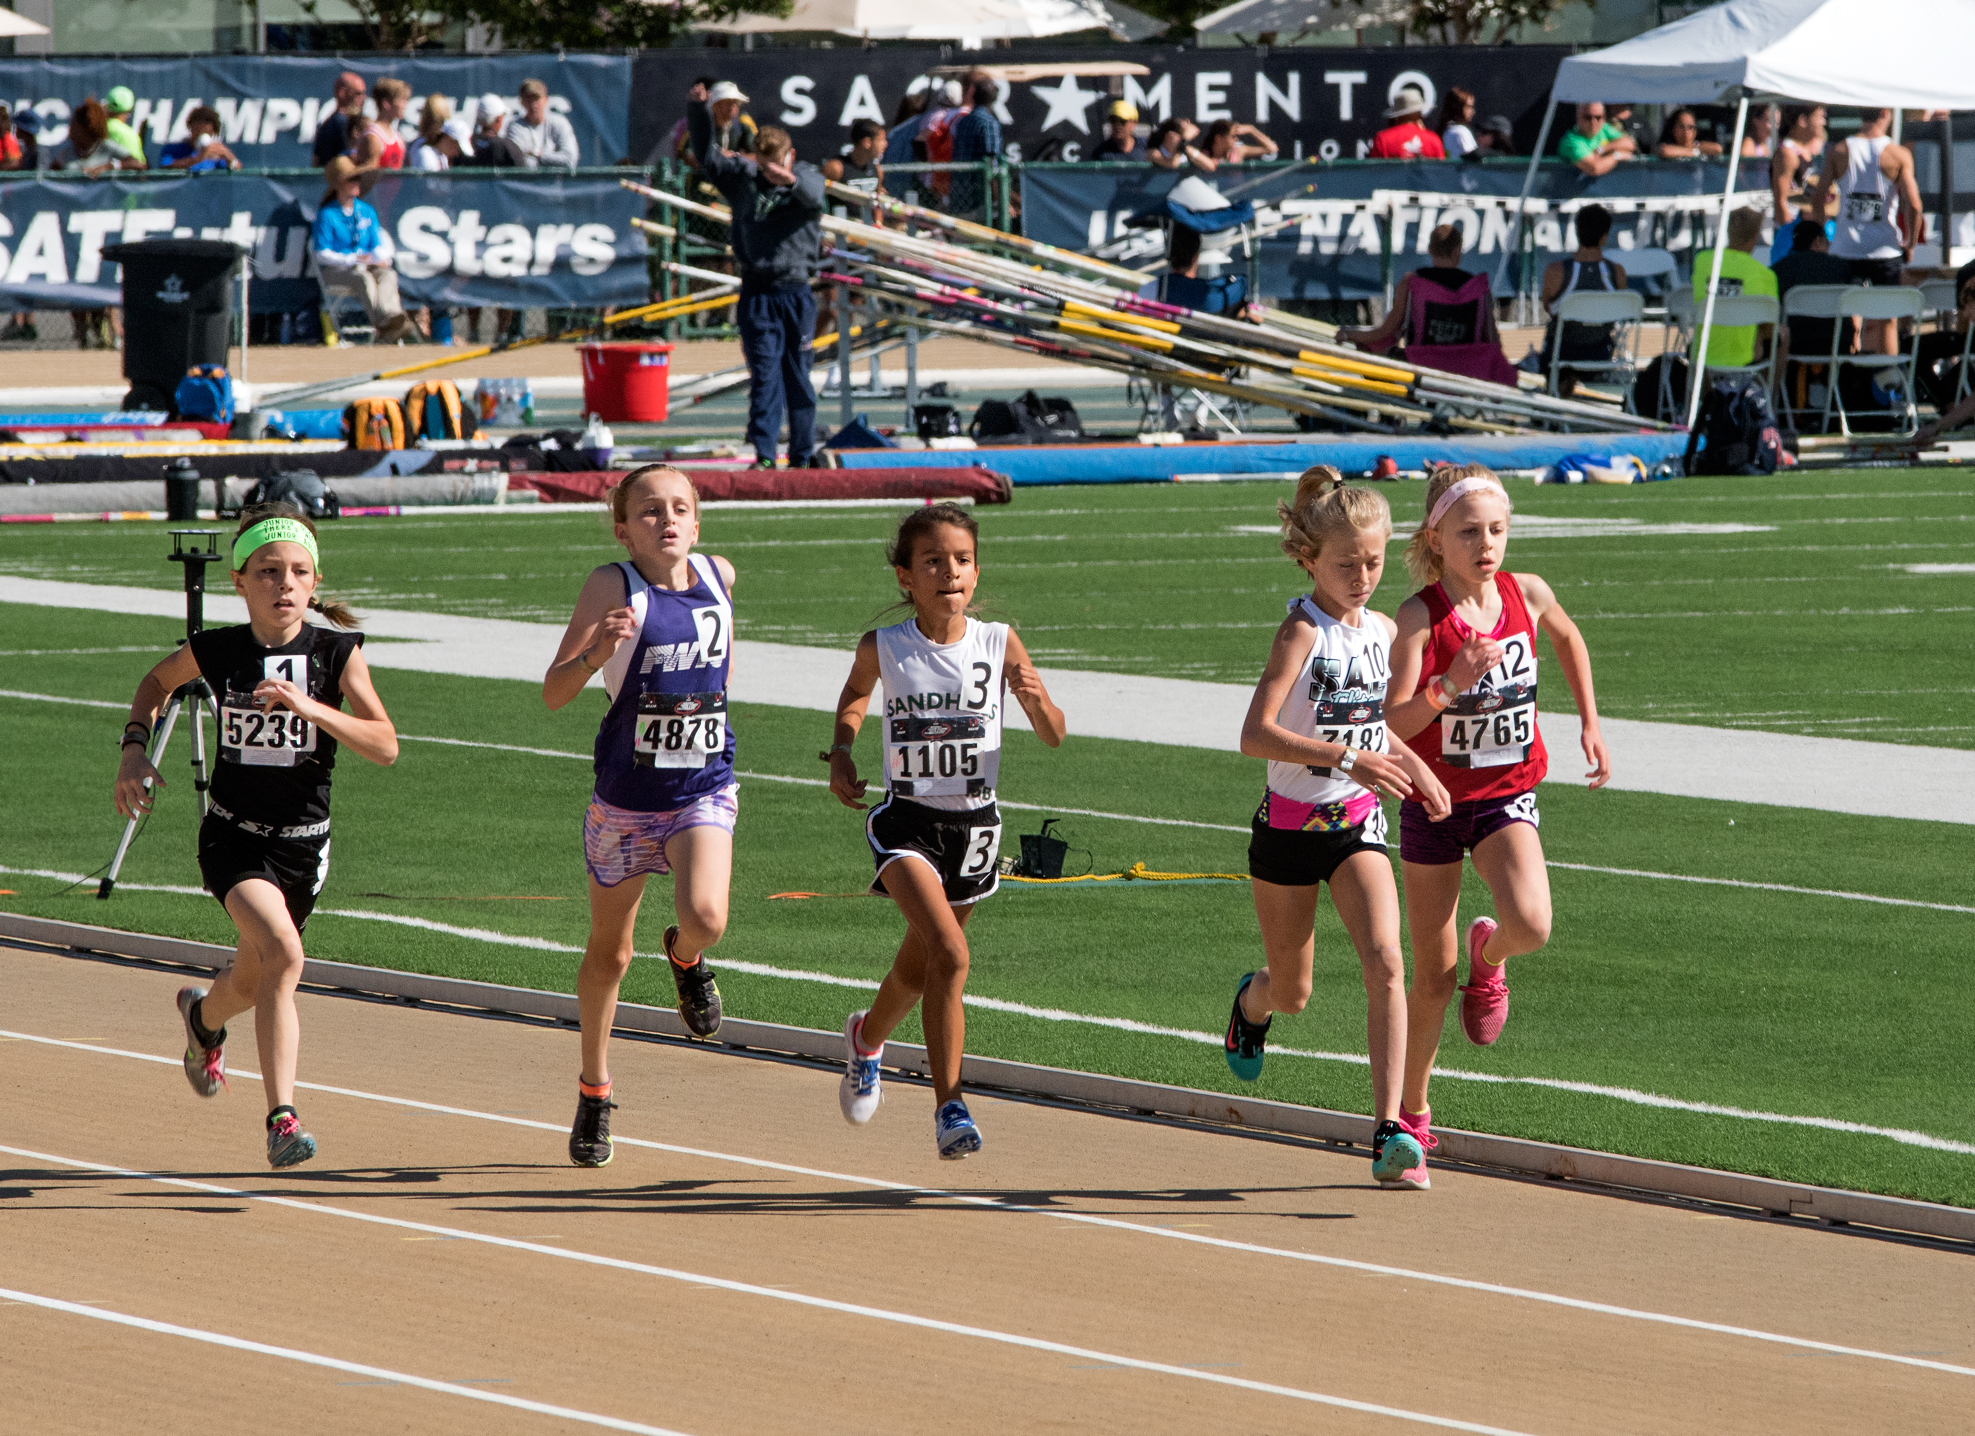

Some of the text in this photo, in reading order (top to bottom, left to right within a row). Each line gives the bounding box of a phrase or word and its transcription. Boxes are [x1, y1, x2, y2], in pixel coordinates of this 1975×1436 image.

[263, 518, 294, 527] JUNIOR
[265, 531, 297, 541] JUNIOR
[701, 610, 722, 657] 2
[276, 658, 294, 682] 1
[1363, 641, 1385, 679] 10
[967, 661, 992, 710] 3
[886, 692, 998, 721] SANDHS
[228, 711, 309, 748] 5239
[643, 718, 719, 751] 4878
[1449, 709, 1530, 751] 4765
[898, 742, 978, 778] 1105
[968, 830, 994, 873] 3
